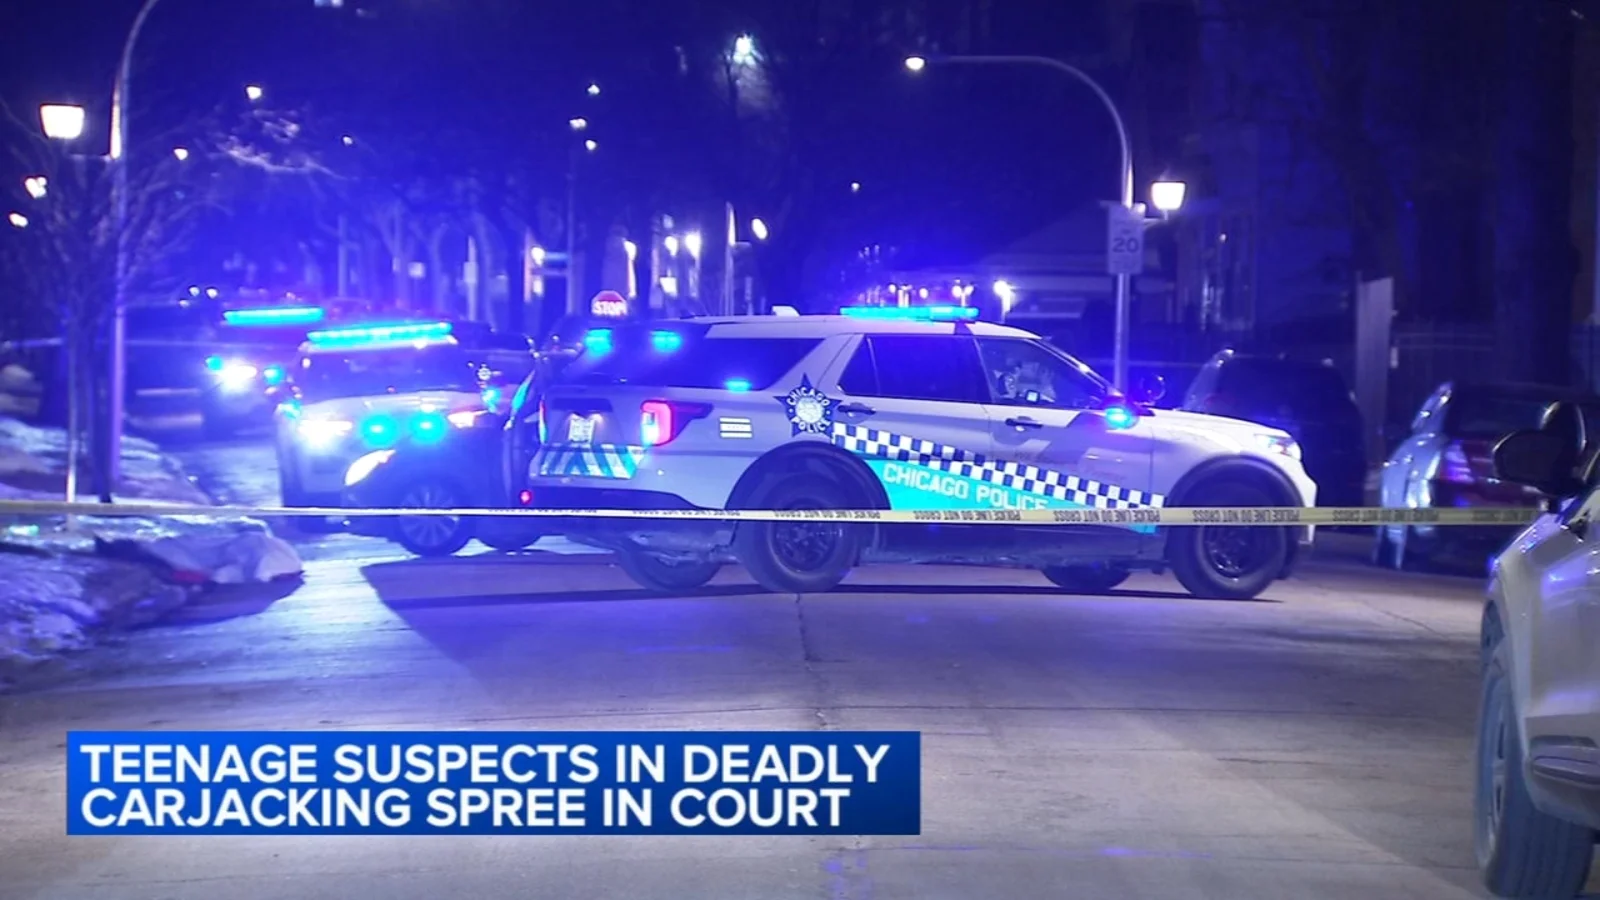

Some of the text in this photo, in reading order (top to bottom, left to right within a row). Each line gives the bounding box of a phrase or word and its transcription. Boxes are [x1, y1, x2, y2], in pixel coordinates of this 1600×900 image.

[1112, 237, 1140, 254] 20
[593, 299, 627, 316] STOP
[786, 386, 831, 407] CHICAGO
[882, 462, 970, 500] CHICAGO
